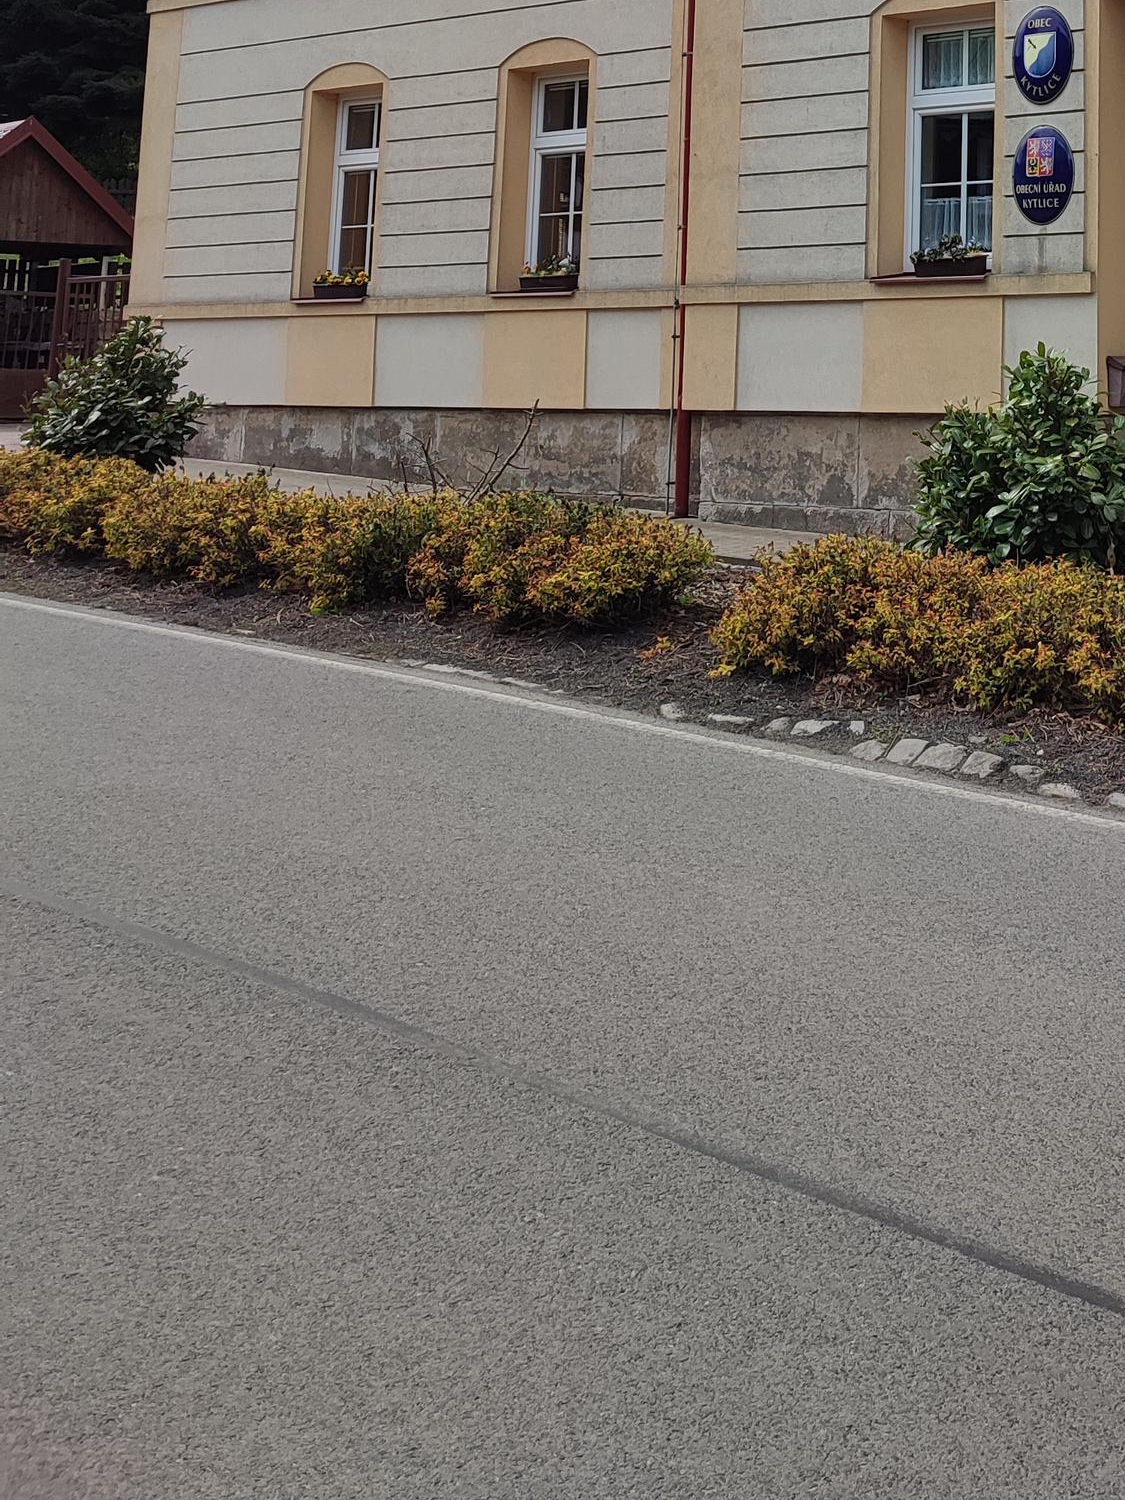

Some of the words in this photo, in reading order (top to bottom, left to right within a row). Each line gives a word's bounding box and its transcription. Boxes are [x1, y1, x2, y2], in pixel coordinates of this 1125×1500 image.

[1027, 18, 1052, 29] OBEC
[1020, 73, 1061, 96] KYTLICE
[1016, 181, 1041, 194] OBECNÍ
[1043, 181, 1067, 193] ÚŘAD
[1022, 198, 1060, 208] KYTLICE
